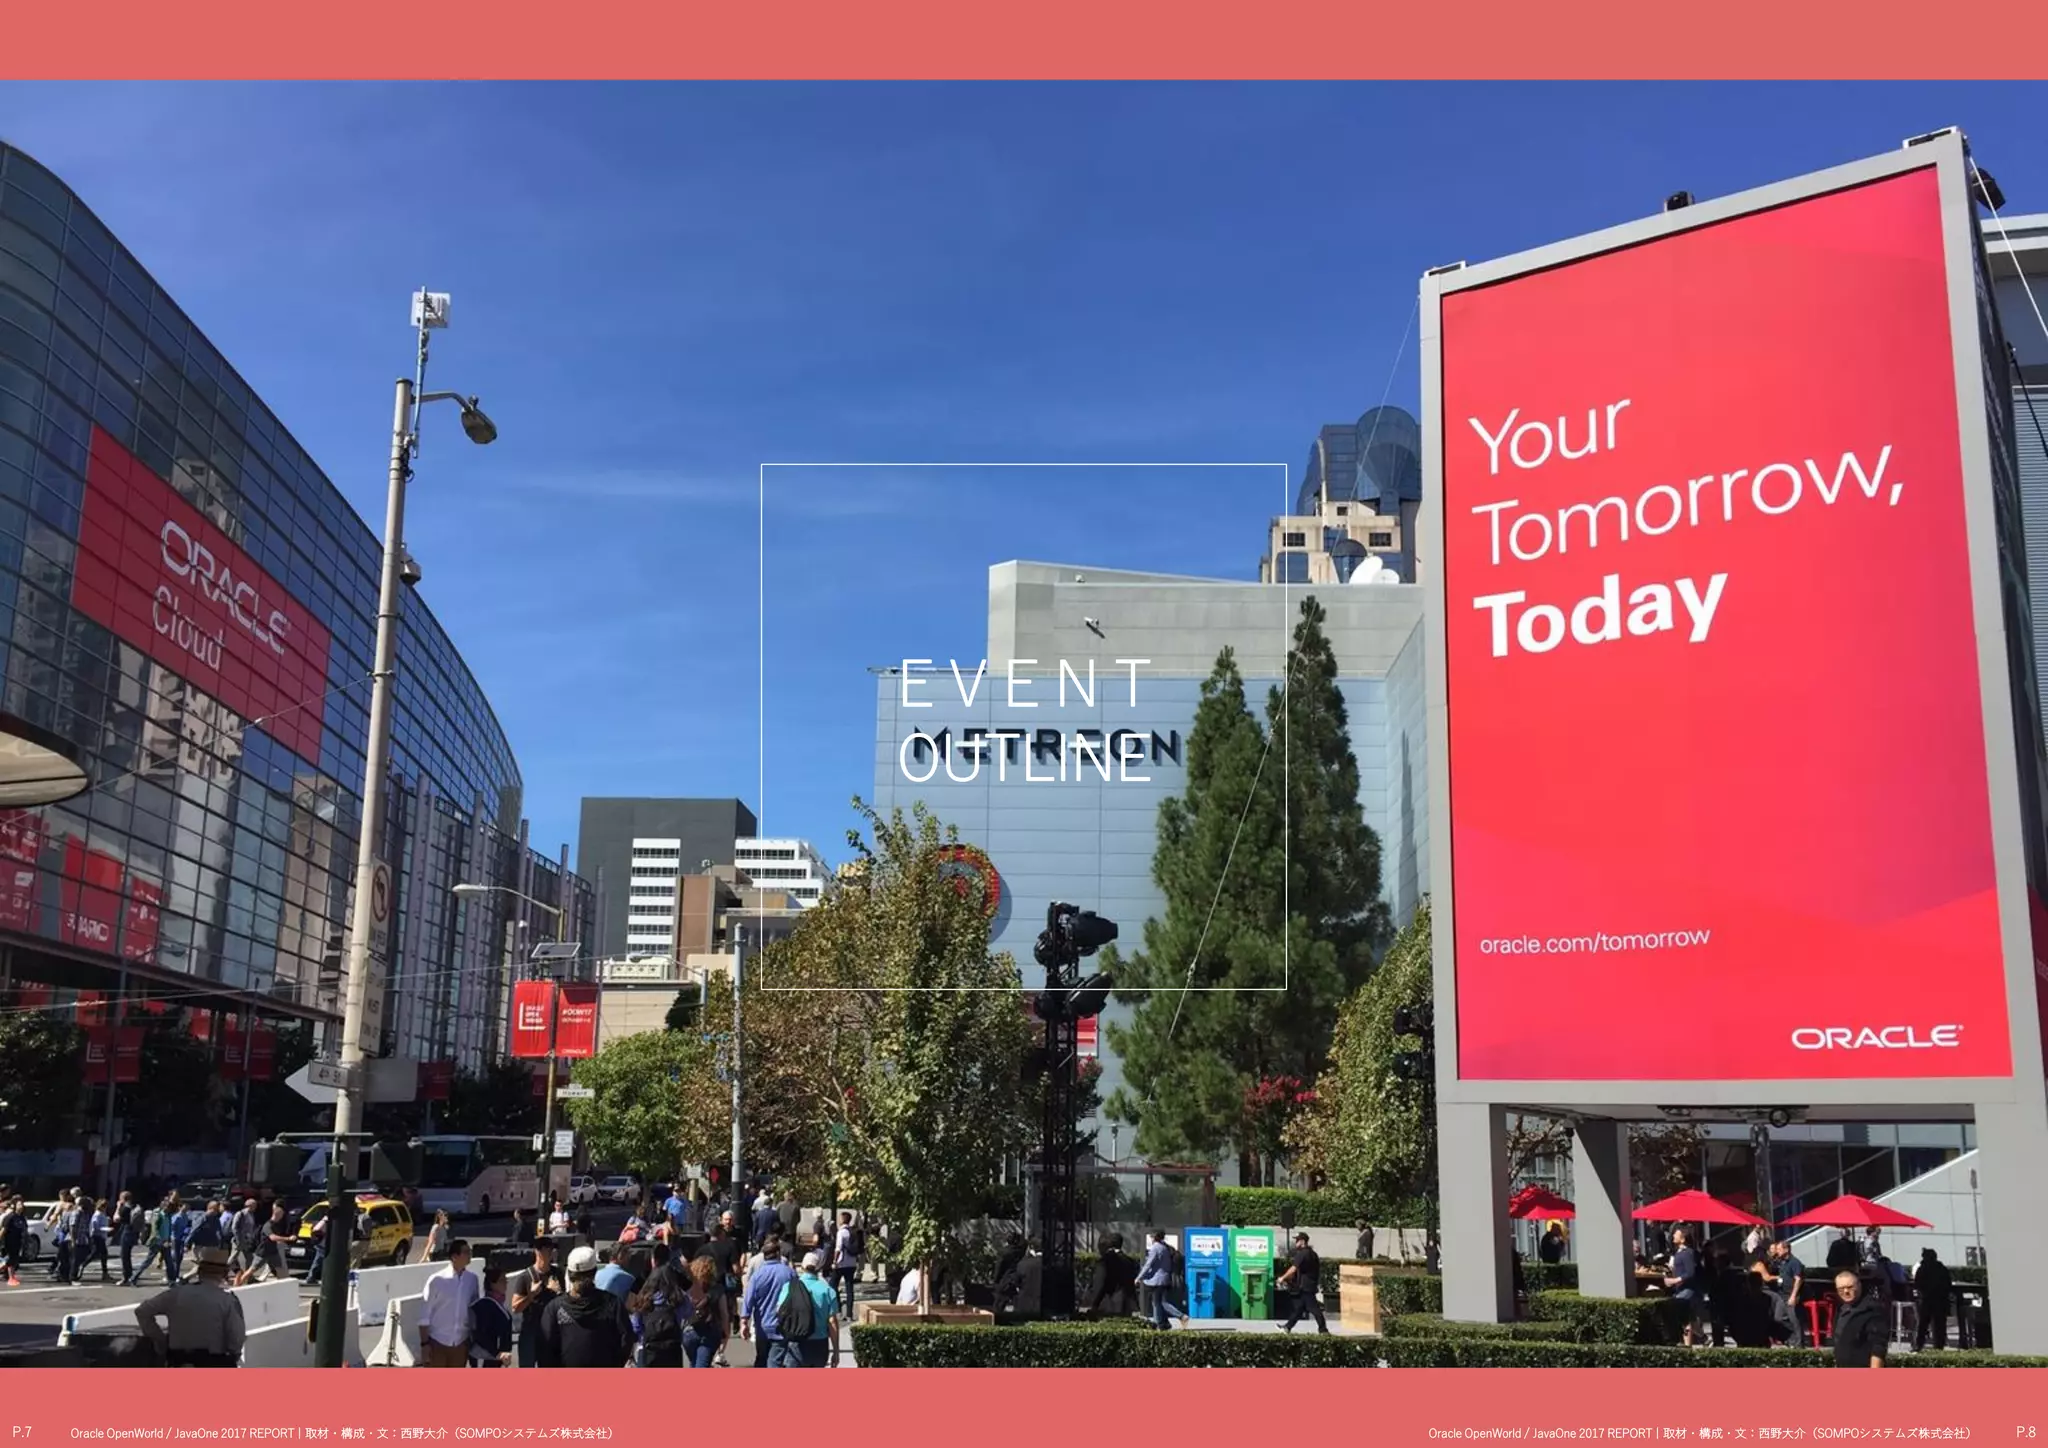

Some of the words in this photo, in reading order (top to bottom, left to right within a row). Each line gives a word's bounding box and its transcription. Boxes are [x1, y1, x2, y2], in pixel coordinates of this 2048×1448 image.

[1469, 398, 1631, 475] Your
[1472, 445, 1904, 565] Tomorrow,
[153, 585, 225, 671] Cloud
[161, 520, 285, 656] ORACLE
[1473, 572, 1729, 658] Today
[913, 726, 1181, 765] METREON
[1481, 925, 1710, 955] oracle.com/tomorrow
[1791, 1024, 1963, 1050] ORACLE
